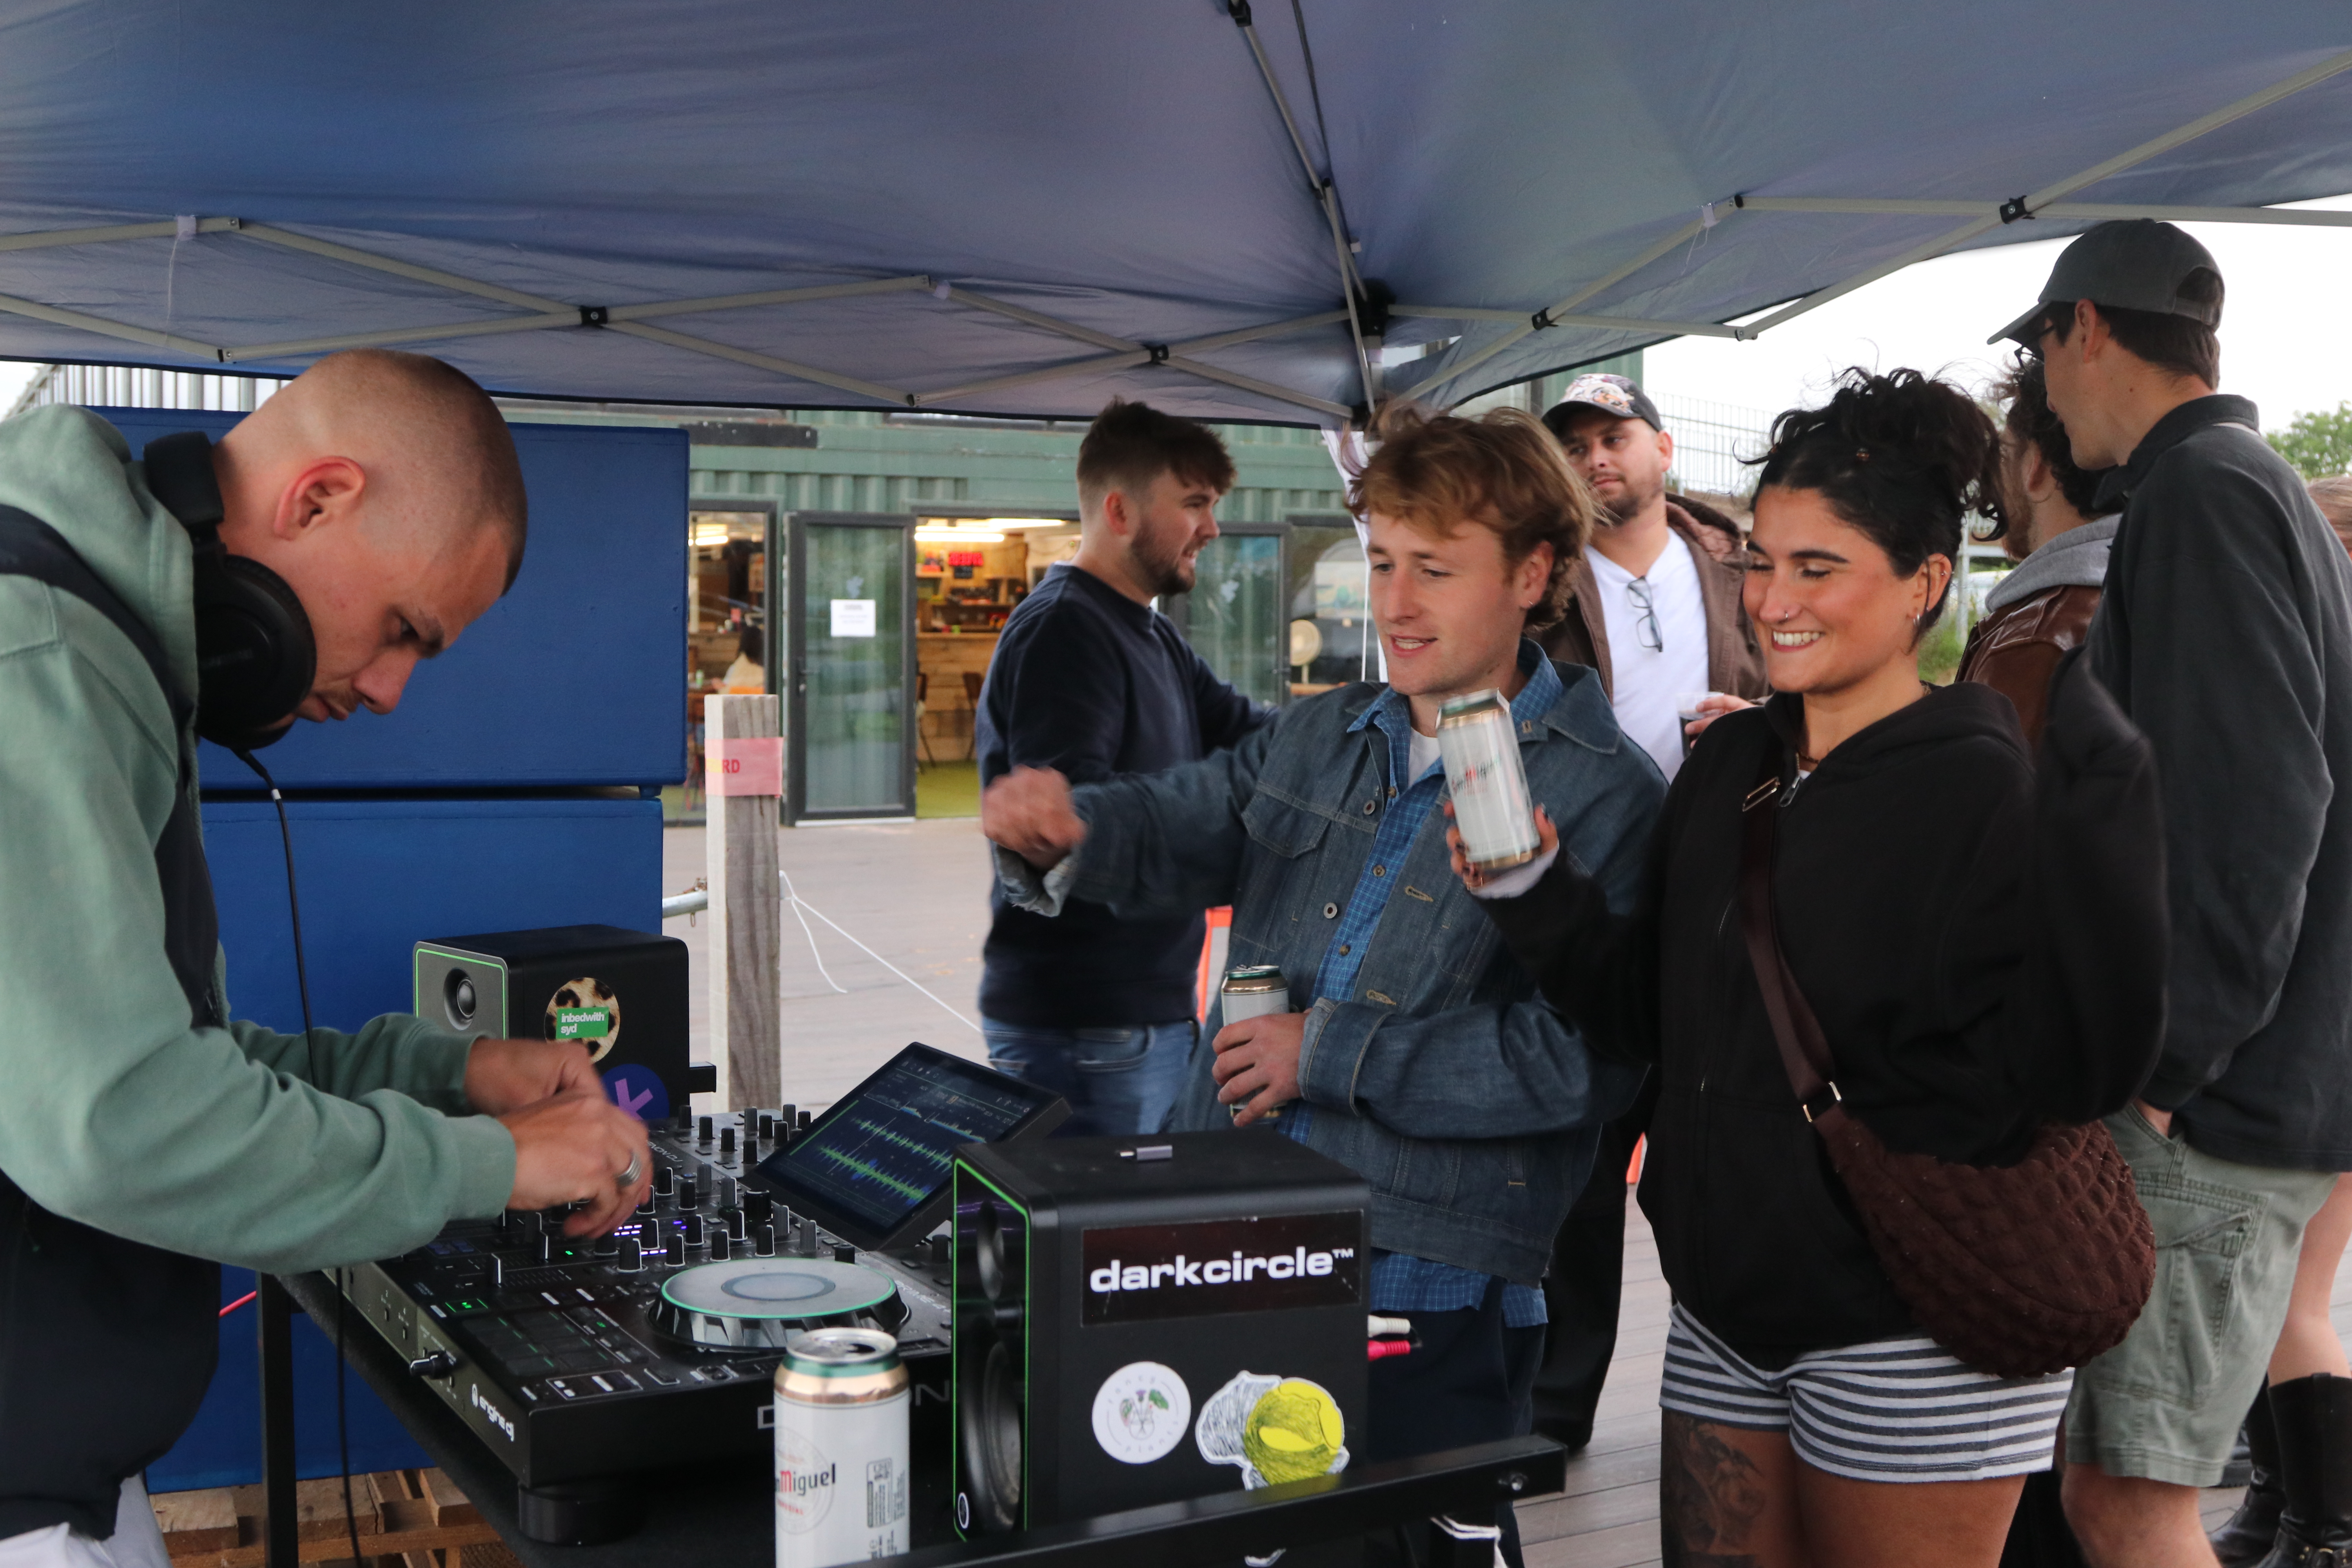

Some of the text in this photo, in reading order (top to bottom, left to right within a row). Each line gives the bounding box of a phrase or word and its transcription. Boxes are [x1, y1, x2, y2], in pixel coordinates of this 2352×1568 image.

[561, 1012, 605, 1023] inbedwith
[561, 1023, 577, 1036] syd
[479, 1396, 515, 1442] engine dj
